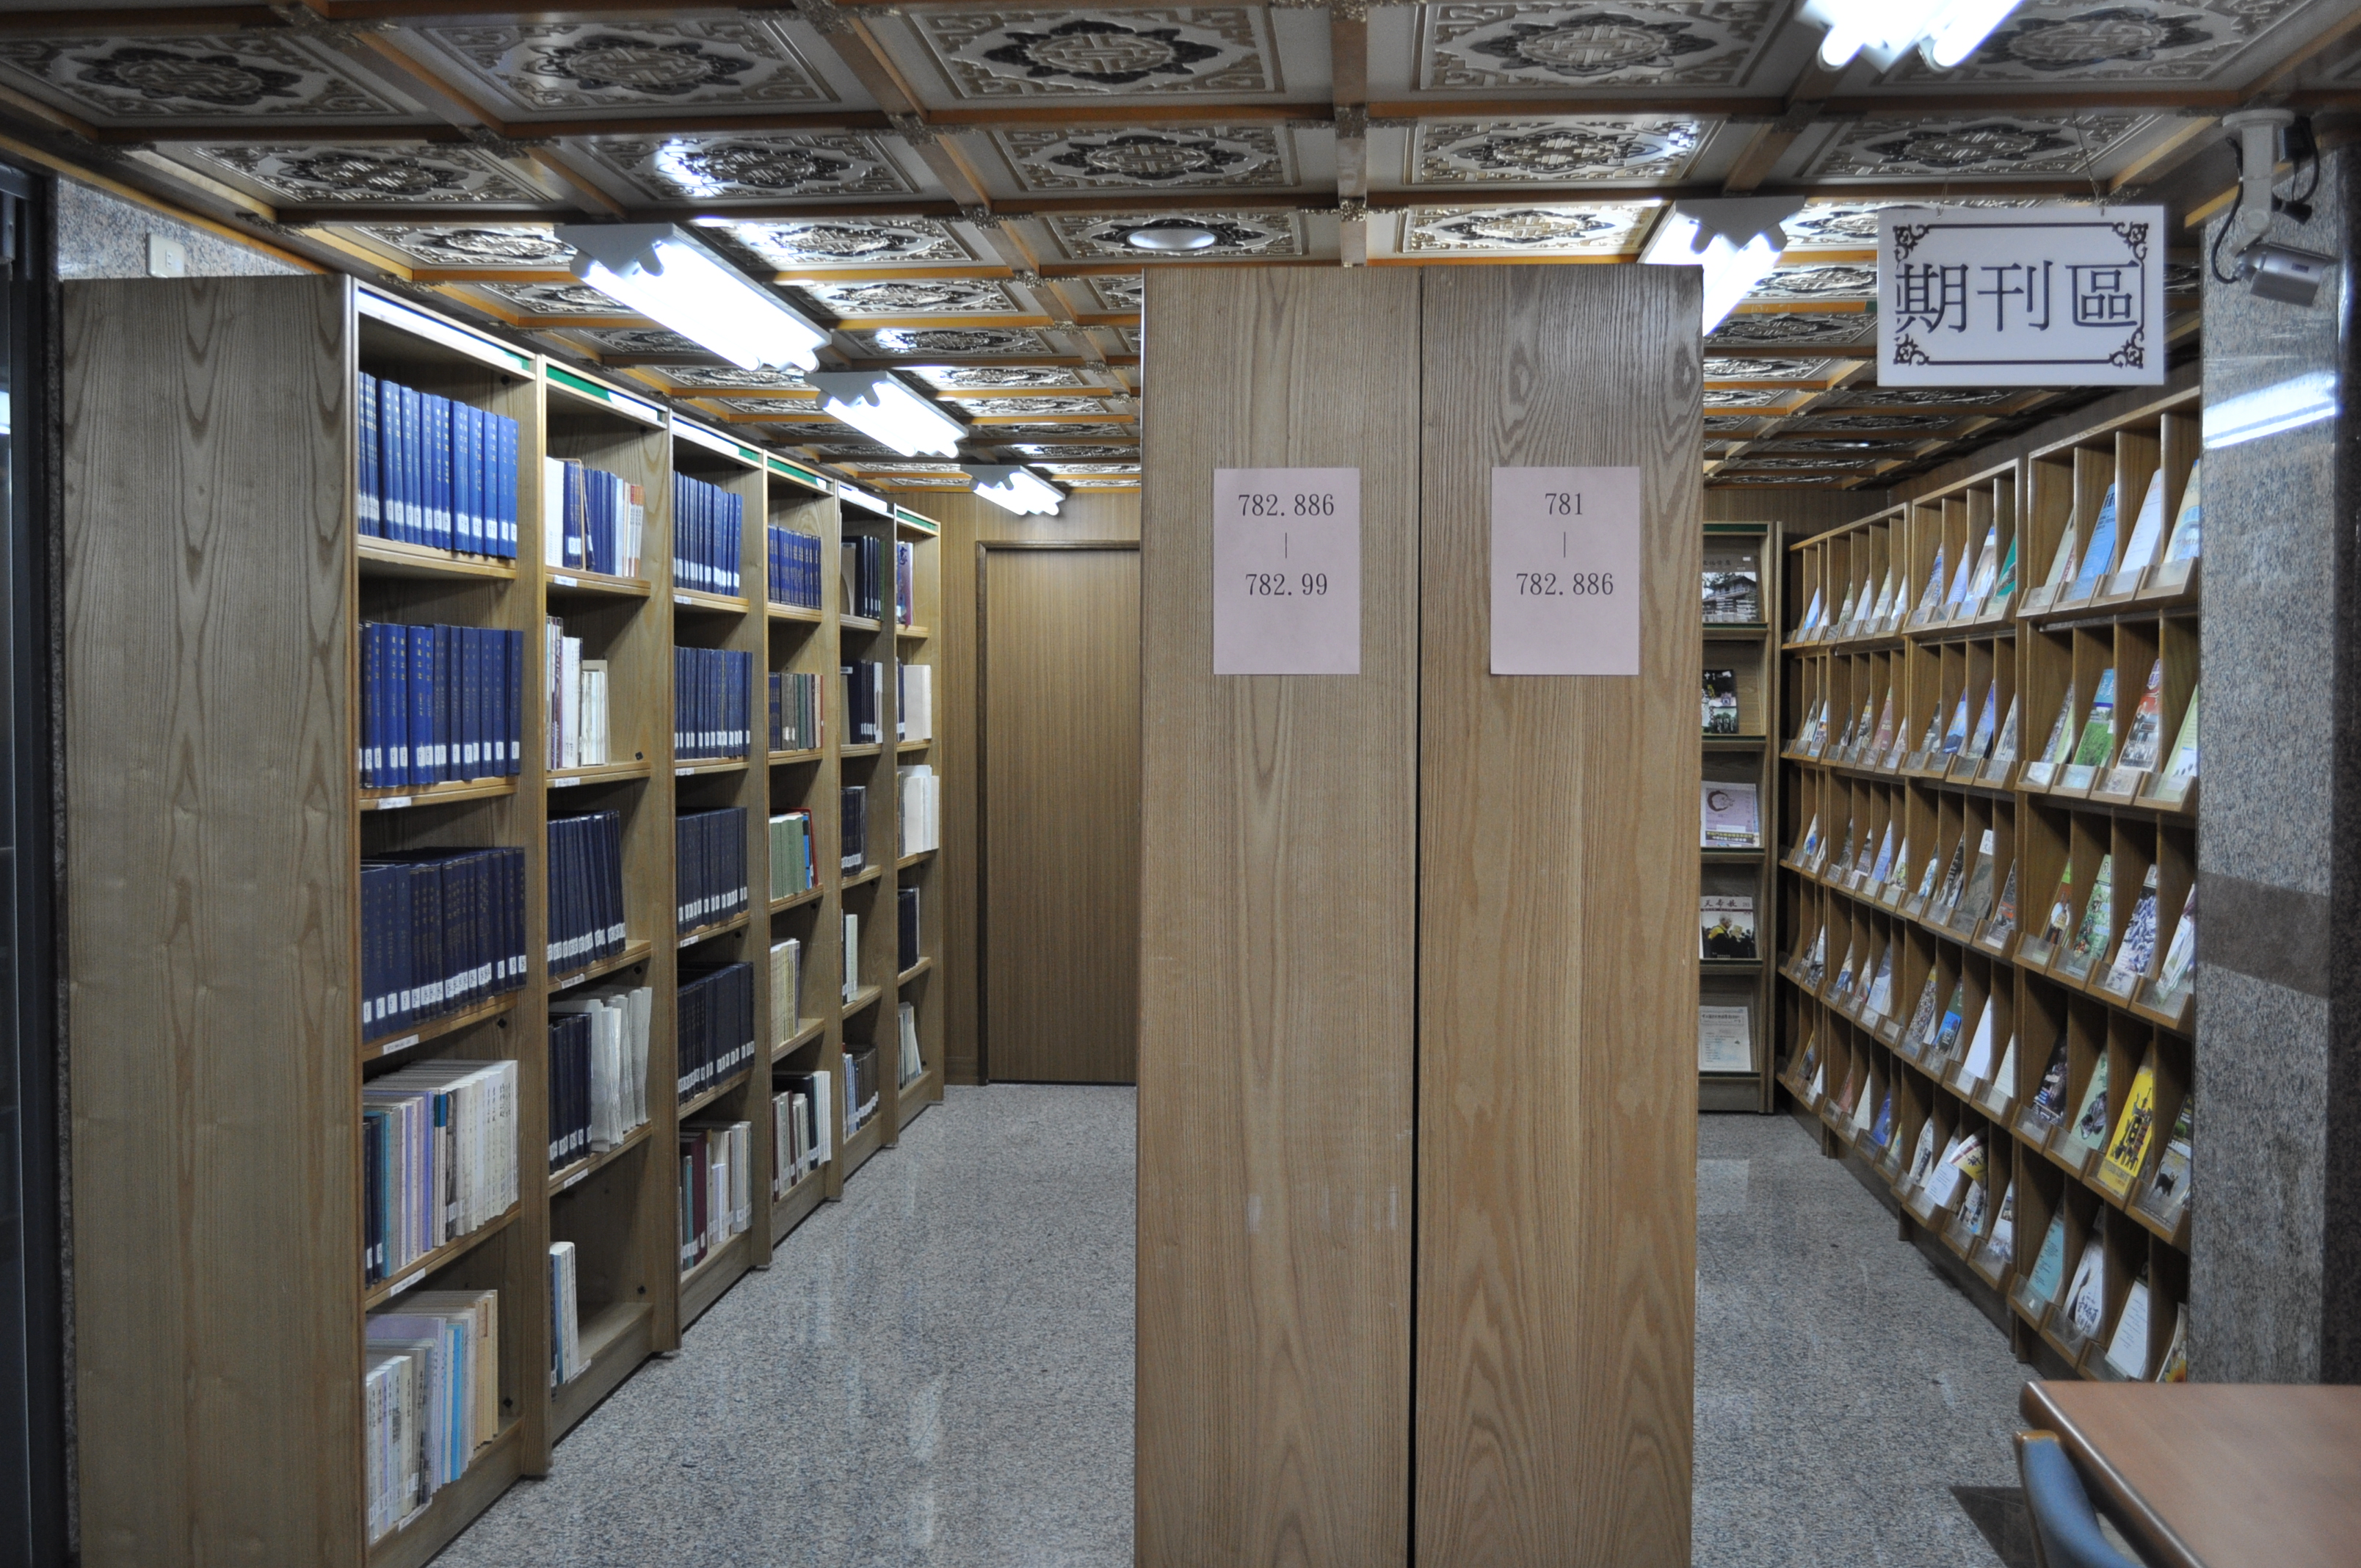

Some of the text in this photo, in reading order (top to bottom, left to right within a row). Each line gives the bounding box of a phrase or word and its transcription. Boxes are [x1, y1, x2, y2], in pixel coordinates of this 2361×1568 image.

[1894, 259, 2139, 334] 期刊區
[1238, 493, 1335, 517] 782.886
[1545, 493, 1583, 515] 781
[1245, 573, 1328, 596] 782.99
[1516, 573, 1614, 596] 782.886
